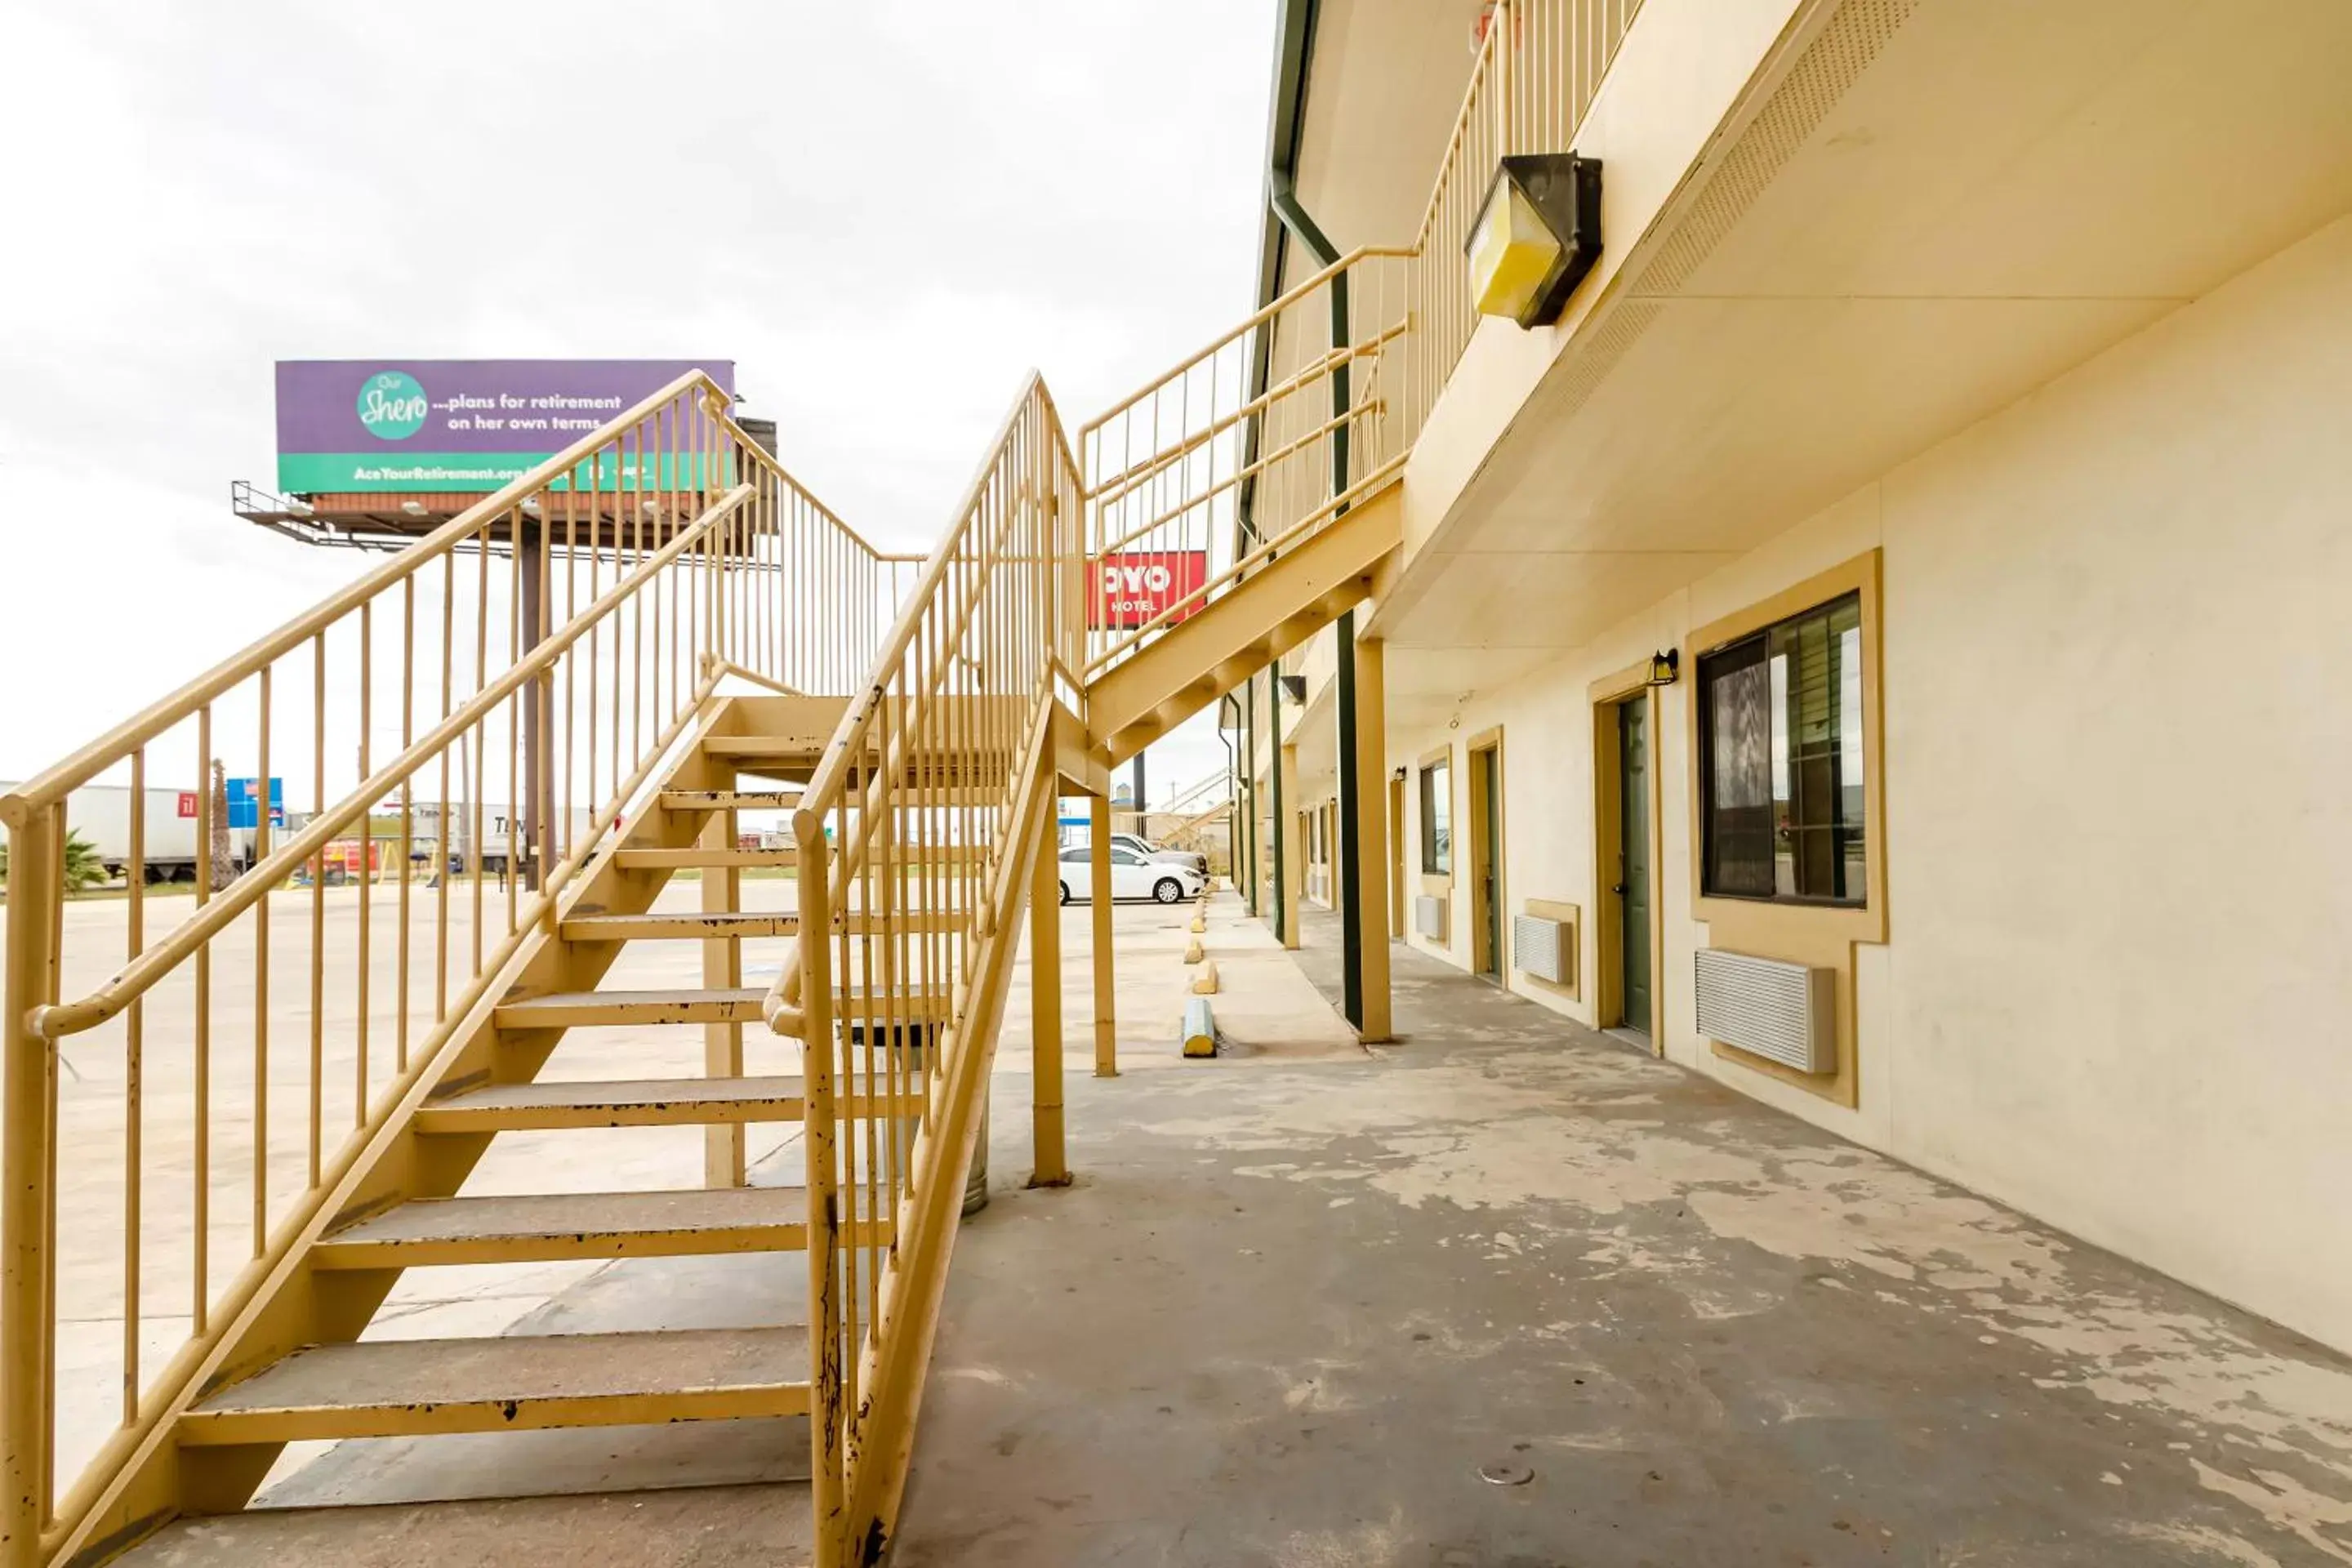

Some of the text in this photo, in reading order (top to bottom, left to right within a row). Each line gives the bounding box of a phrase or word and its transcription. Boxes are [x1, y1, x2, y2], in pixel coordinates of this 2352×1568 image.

[377, 376, 402, 390] Our
[361, 390, 427, 424] Shero
[500, 394, 525, 408] for
[531, 394, 621, 408] retirement
[448, 418, 470, 430] on
[474, 414, 504, 430] her
[509, 418, 546, 430] own
[1105, 565, 1170, 594] OYO
[1111, 600, 1157, 612] HOTEL
